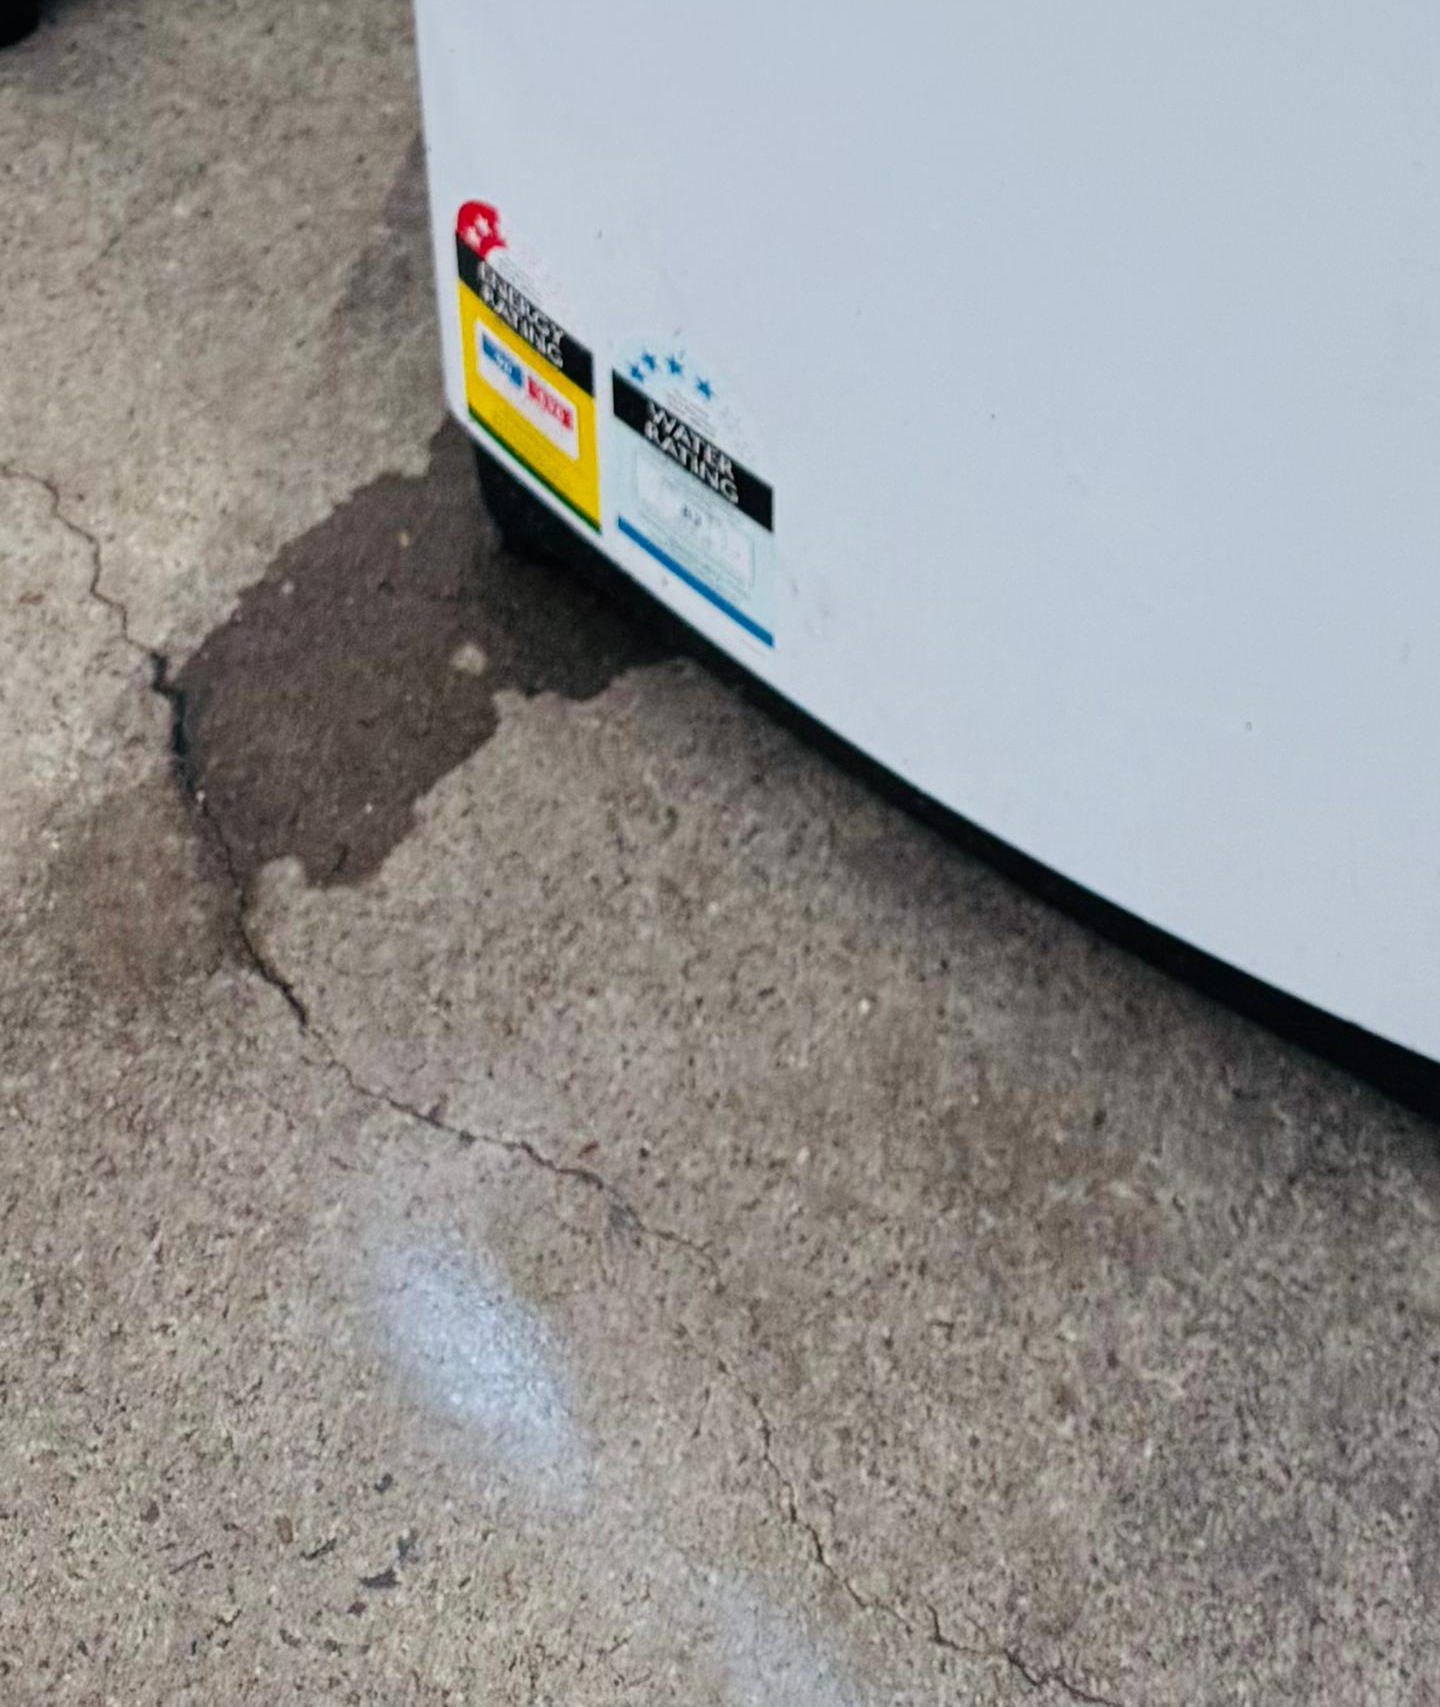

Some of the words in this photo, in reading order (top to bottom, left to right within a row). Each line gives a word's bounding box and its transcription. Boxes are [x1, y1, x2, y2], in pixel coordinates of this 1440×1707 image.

[478, 260, 564, 345] ENERGY
[480, 284, 564, 368] RATING
[644, 421, 739, 505] RATING
[648, 401, 735, 481] WATER
